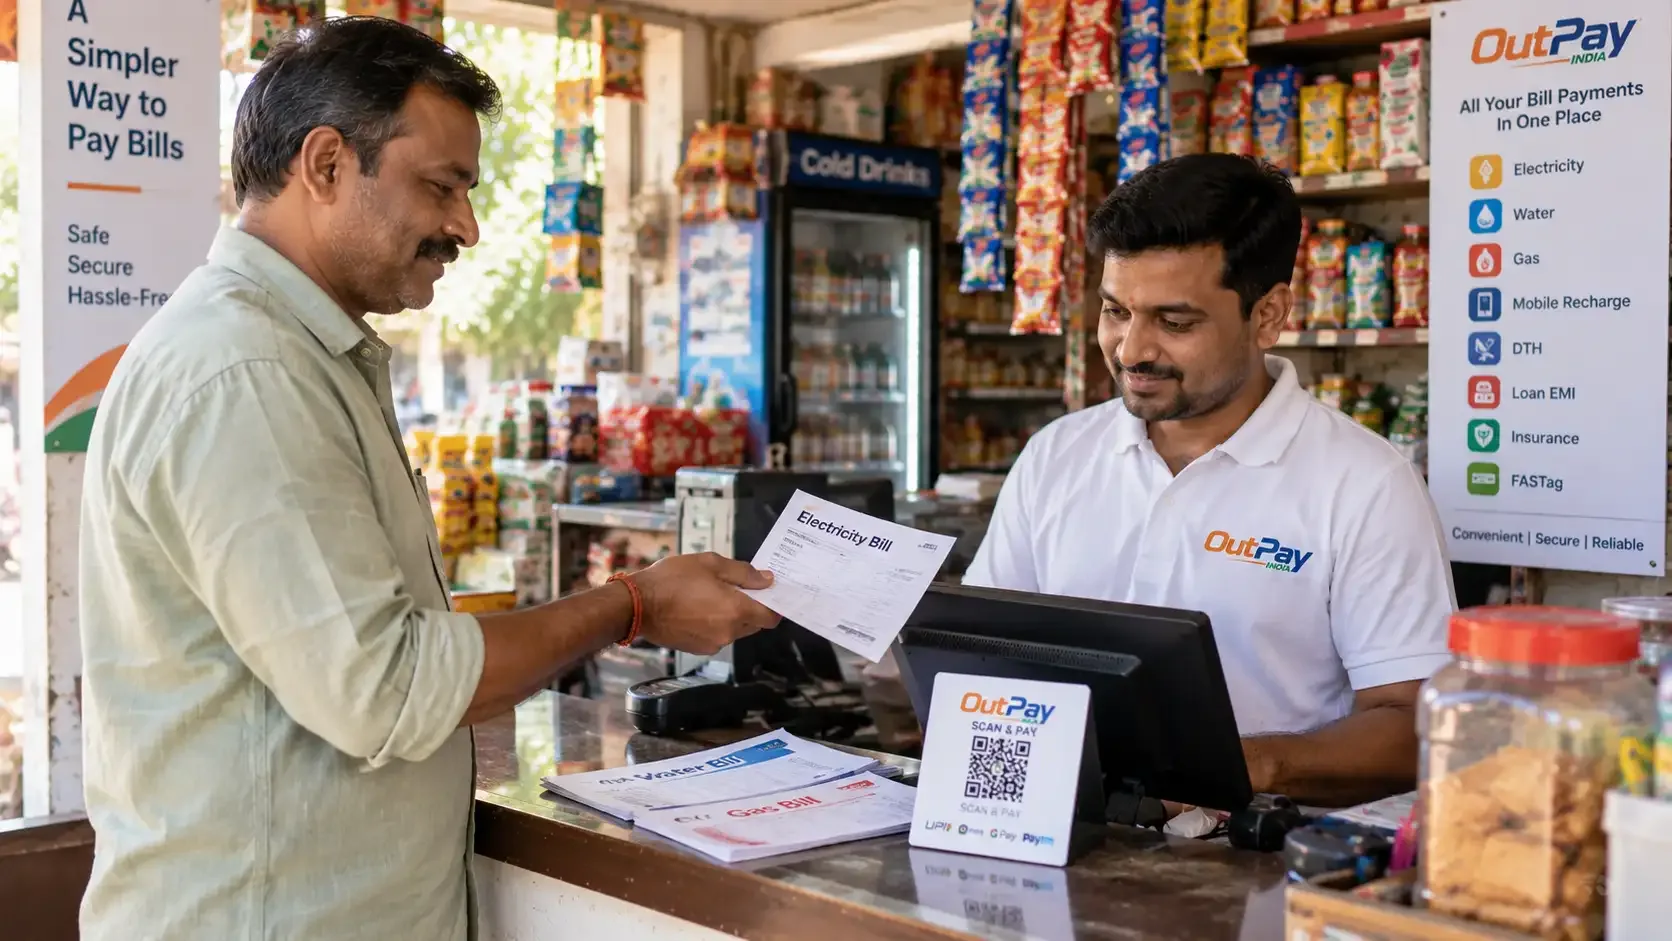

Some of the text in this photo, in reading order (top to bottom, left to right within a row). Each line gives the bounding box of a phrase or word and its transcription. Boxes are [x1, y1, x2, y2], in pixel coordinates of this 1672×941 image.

[67, 0, 88, 23] A
[1471, 17, 1637, 64] OutPay
[68, 37, 179, 79] Simpler
[1570, 52, 1606, 65] INDIA
[67, 80, 167, 120] Way to
[1459, 82, 1644, 115] All Your Bill Payments
[1497, 108, 1602, 132] In One Place
[68, 123, 184, 160] Pay Bills
[801, 148, 930, 189] Cold Drinks
[1513, 158, 1585, 176] Electricity
[1513, 207, 1556, 221] Water
[68, 224, 110, 246] Safe
[68, 255, 134, 277] Secure
[1513, 252, 1540, 266] Gas
[67, 285, 174, 307] Hassle-Fre
[1512, 295, 1631, 311] Mobile Recharge
[1512, 342, 1543, 355] DTH
[1511, 387, 1576, 400] Loan EMI
[1511, 430, 1580, 445] Insurance
[1511, 475, 1564, 492] FASTag
[796, 510, 868, 547] Electricity
[868, 535, 893, 552] Bill
[1452, 527, 1523, 544] Convenient
[1535, 533, 1580, 548] Secure
[1592, 536, 1645, 552] Reliable
[1204, 530, 1313, 572] OutPay
[960, 692, 1056, 724] OutPay
[971, 721, 1038, 737] SCAN & PAY
[727, 804, 779, 818] Gas
[777, 795, 823, 810] Bill
[960, 802, 988, 816] SCAN
[925, 820, 947, 831] UPI
[1000, 830, 1017, 842] Pay
